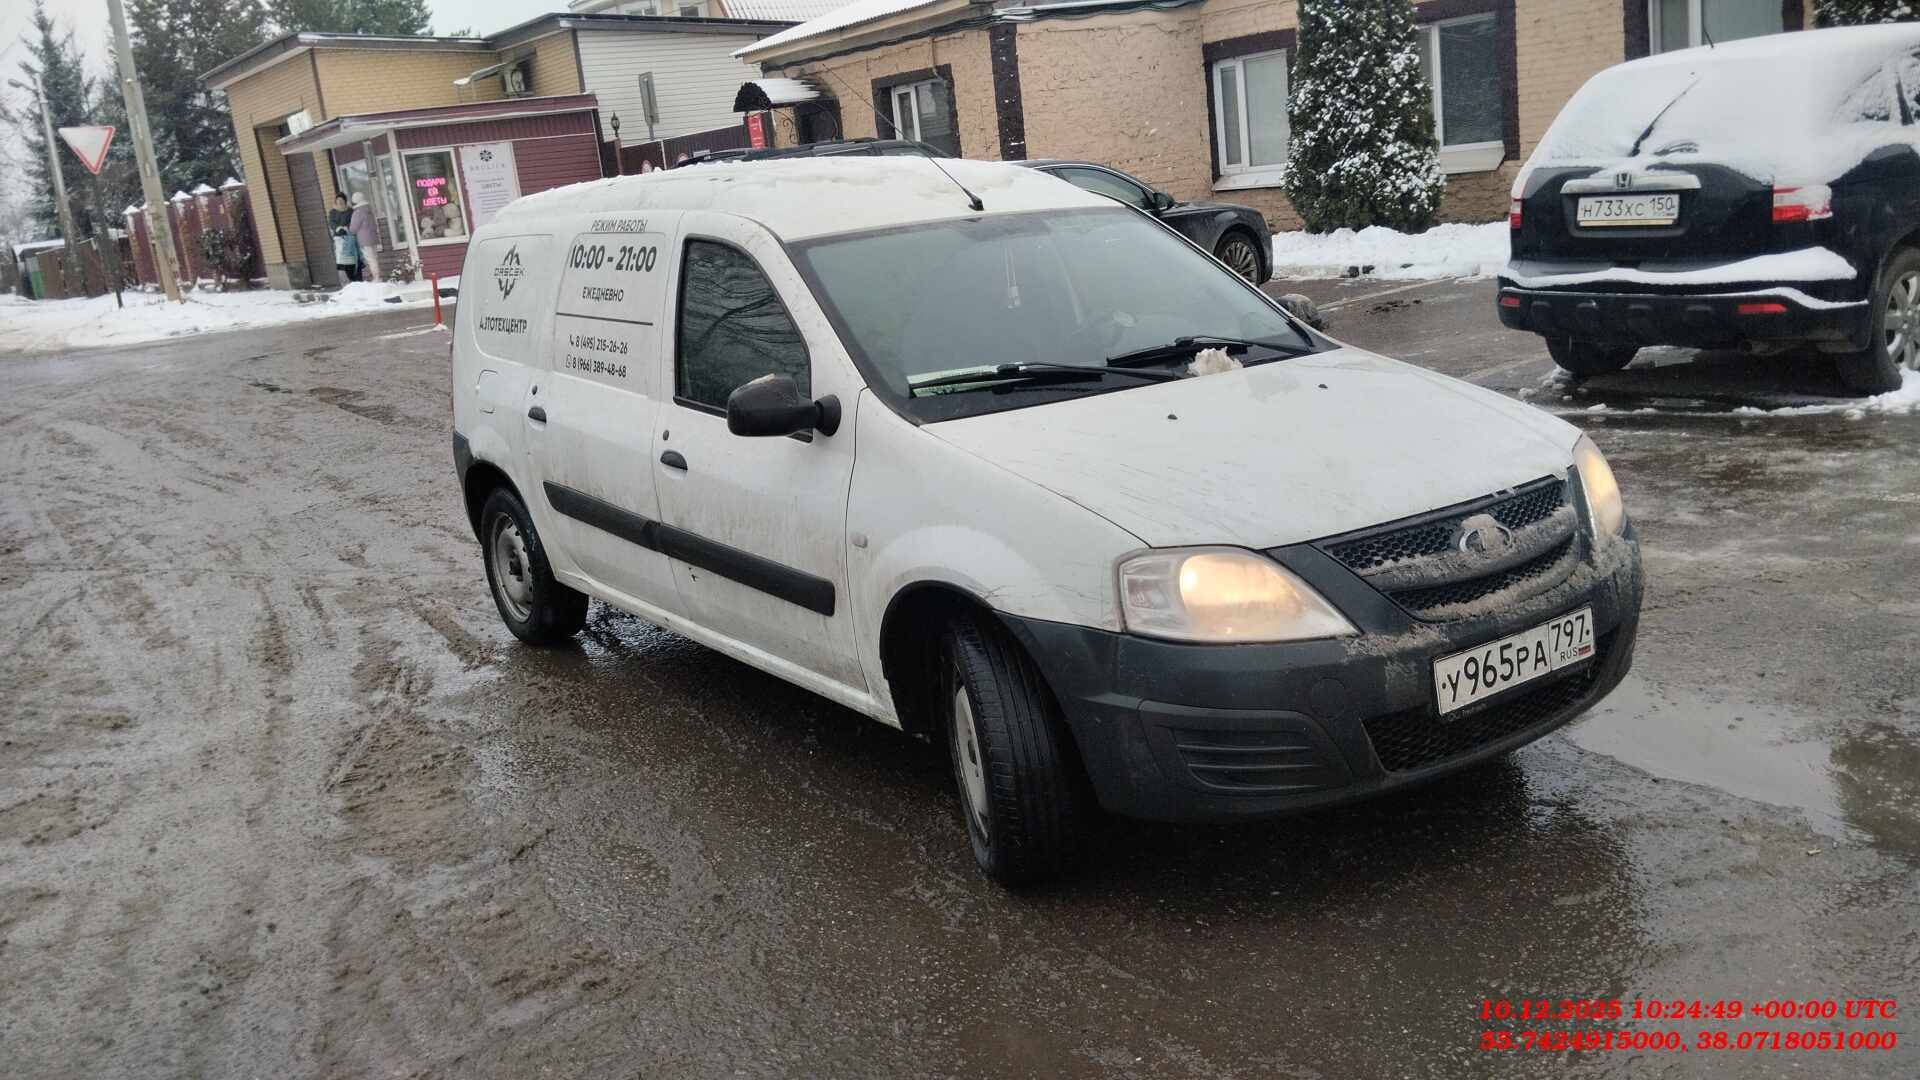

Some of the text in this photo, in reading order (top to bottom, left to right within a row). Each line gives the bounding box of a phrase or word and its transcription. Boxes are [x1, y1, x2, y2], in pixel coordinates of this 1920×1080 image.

[1583, 196, 1674, 217] Н733ХС 150
[590, 219, 649, 233] РЕЖИМ РАБОТЫ
[569, 244, 606, 270] 10:00
[615, 245, 657, 273] 21:00
[582, 286, 625, 302] ЕЖЕДНЕВНО
[575, 334, 628, 354] 8 (495) 215-26-26
[572, 356, 627, 378] 8 (966) 389-48-68
[1447, 614, 1585, 702] У965РА 797
[1560, 647, 1578, 662] RUS
